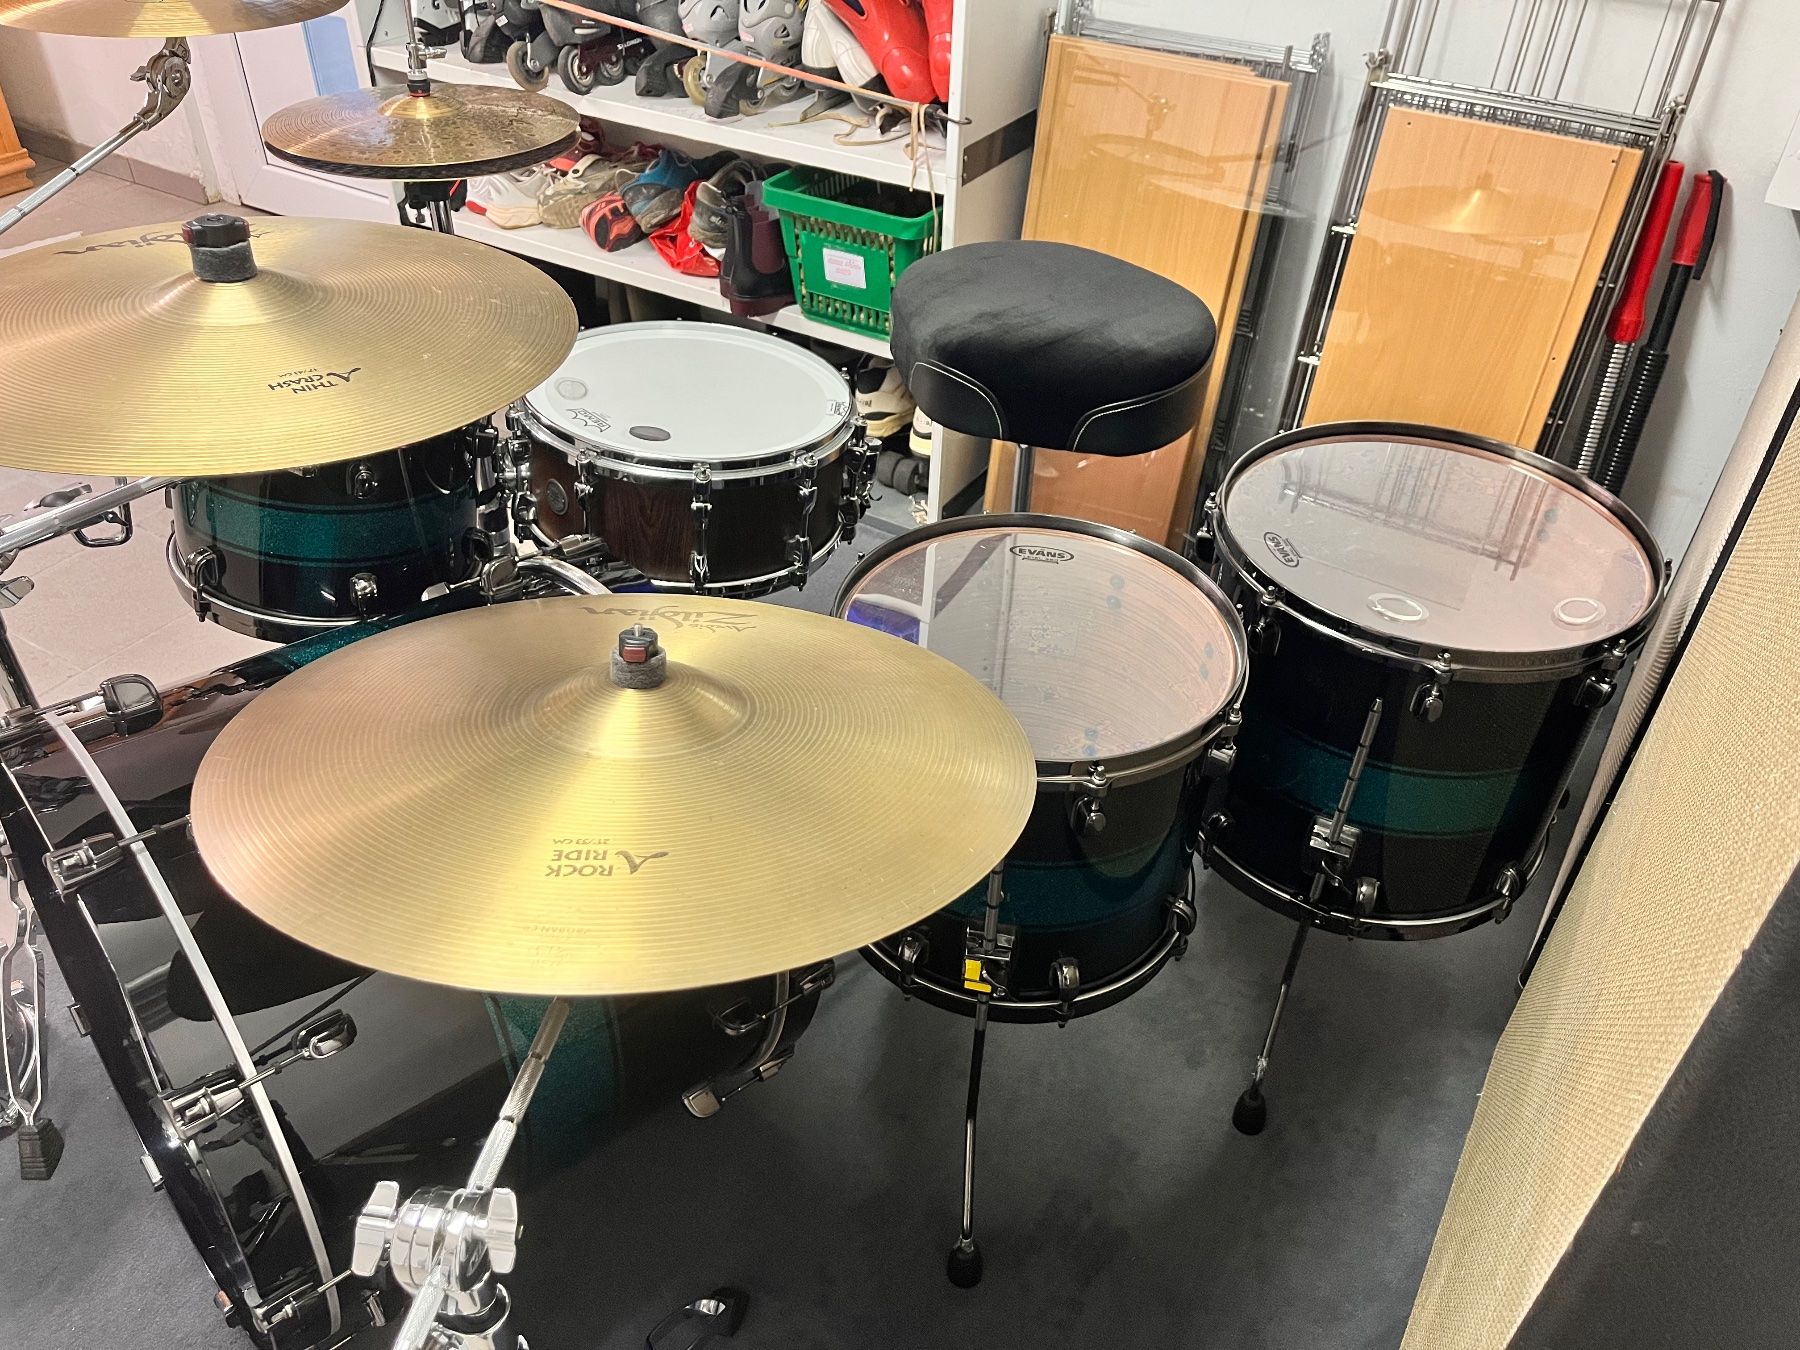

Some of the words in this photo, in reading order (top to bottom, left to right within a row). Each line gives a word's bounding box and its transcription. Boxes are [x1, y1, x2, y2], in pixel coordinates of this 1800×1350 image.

[267, 374, 324, 391] CRASH
[291, 380, 339, 394] THIN
[577, 410, 606, 428] REMO
[1018, 547, 1066, 559] EVANS
[1267, 536, 1296, 563] EVANS
[576, 605, 758, 630] Zildjian
[551, 849, 609, 862] RIDE
[544, 864, 614, 877] ROCK
